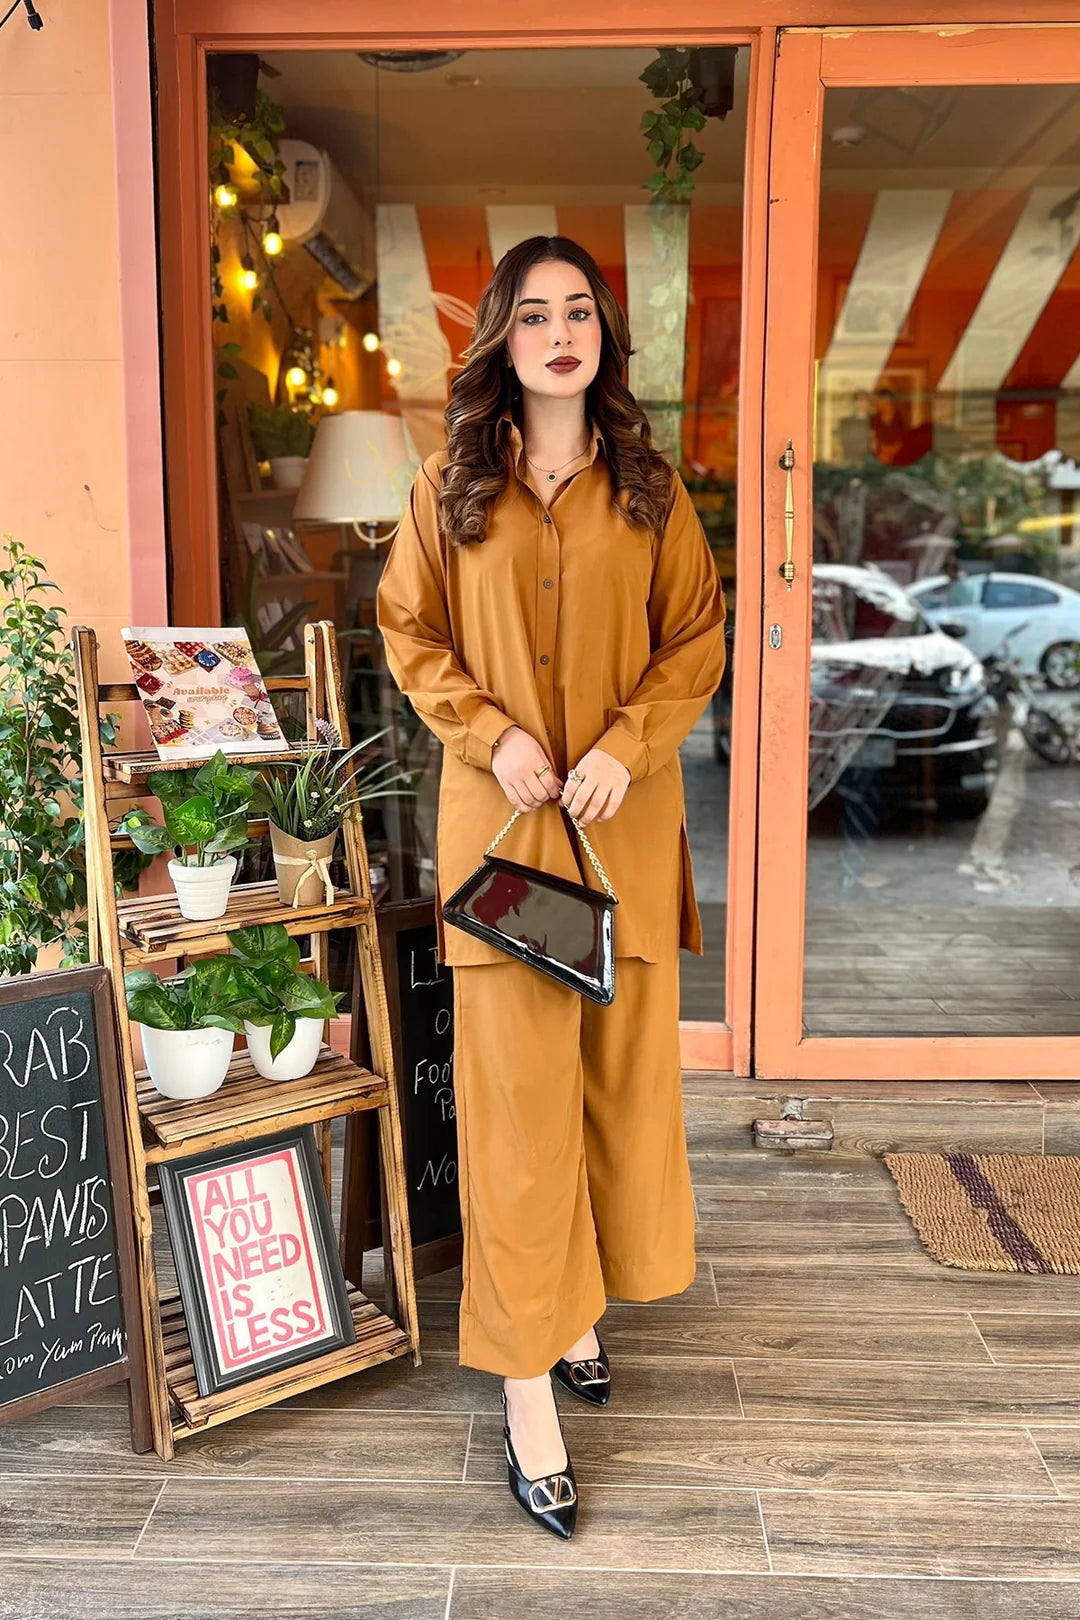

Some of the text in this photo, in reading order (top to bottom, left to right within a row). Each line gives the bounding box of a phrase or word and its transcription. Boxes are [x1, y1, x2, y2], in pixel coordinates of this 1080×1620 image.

[173, 686, 230, 696] Available
[204, 1169, 268, 1216] ALL
[204, 1200, 272, 1249] YOU
[213, 1233, 301, 1288] NEED
[220, 1284, 254, 1321] IS
[227, 1300, 316, 1358] LESS
